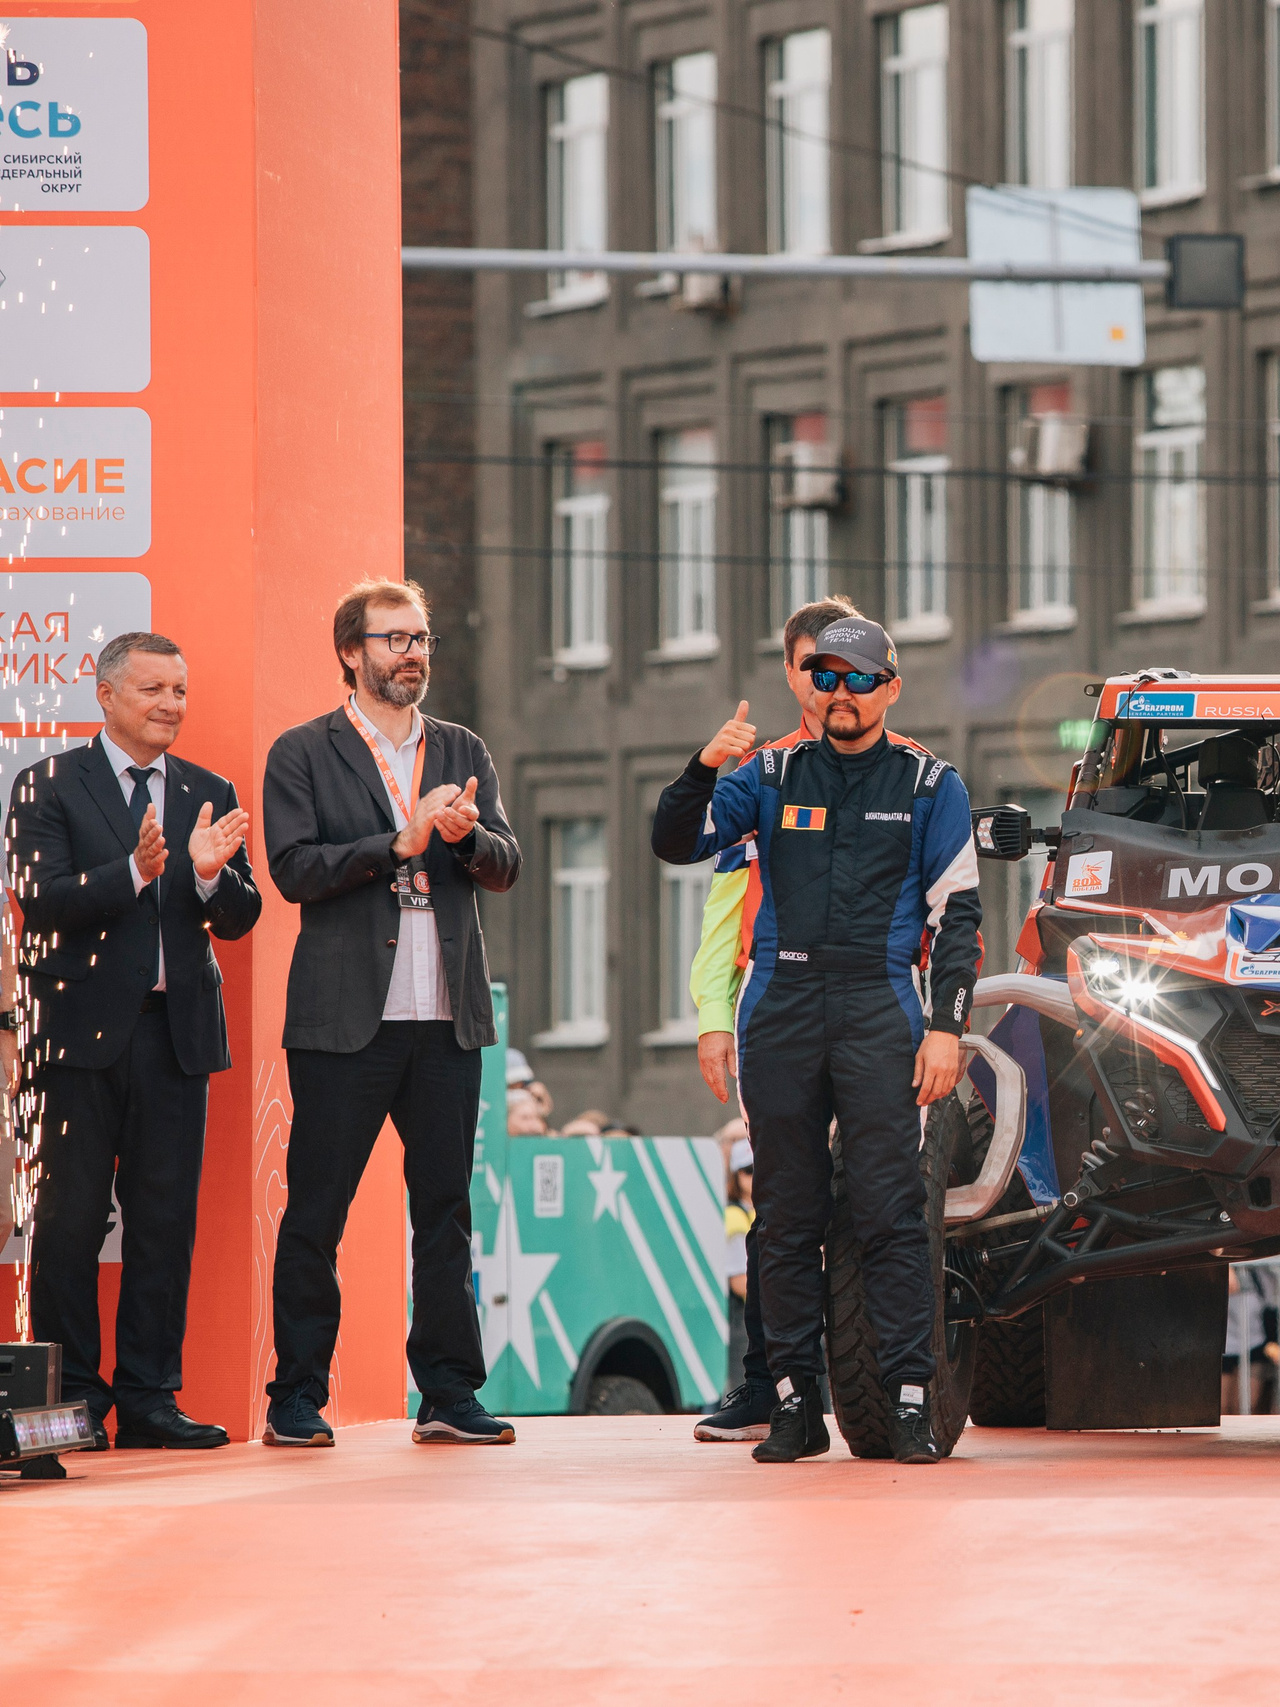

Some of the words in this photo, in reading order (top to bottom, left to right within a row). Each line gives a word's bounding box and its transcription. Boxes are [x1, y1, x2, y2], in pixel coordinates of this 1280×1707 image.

[4, 152, 82, 164] СИБИРСКИЙ
[41, 184, 82, 193] ОКРУГ
[0, 612, 69, 643] АЯ
[824, 627, 867, 637] MONGOLIAN
[824, 633, 860, 642] NATIONAL
[1144, 704, 1184, 712] GAZPROM
[1204, 706, 1274, 717] RUSSIA
[763, 749, 776, 774] parco
[410, 896, 429, 907] VIP
[778, 950, 808, 962] sparco
